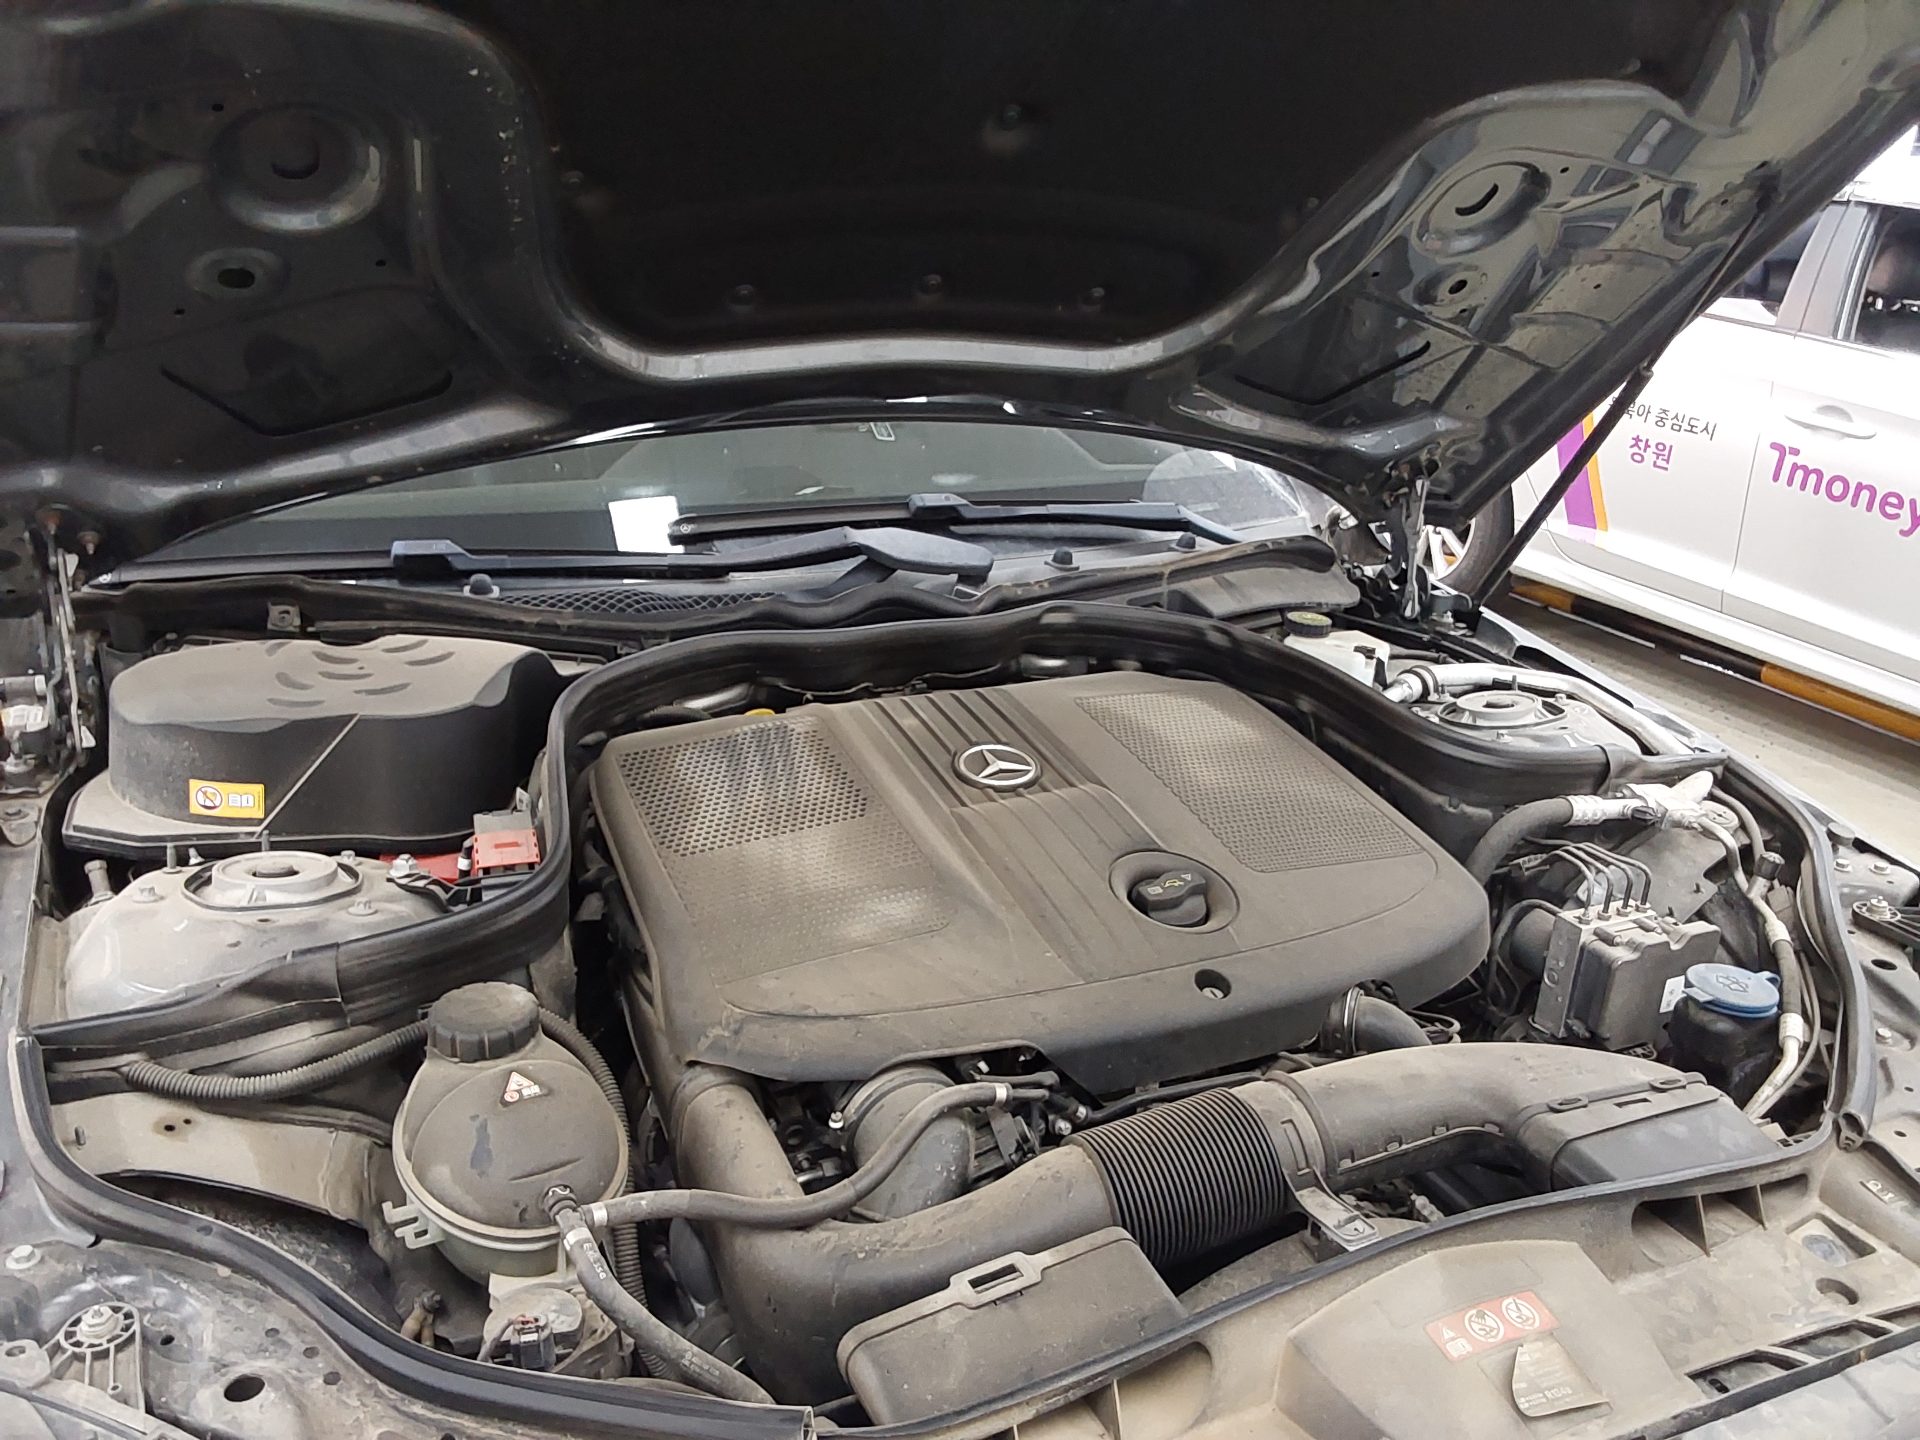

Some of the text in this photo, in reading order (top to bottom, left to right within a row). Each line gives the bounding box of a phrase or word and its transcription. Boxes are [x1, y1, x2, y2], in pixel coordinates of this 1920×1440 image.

[1655, 408, 1717, 441] 중심도시
[1629, 434, 1673, 471] 창원
[1769, 441, 1920, 538] Tmoney
